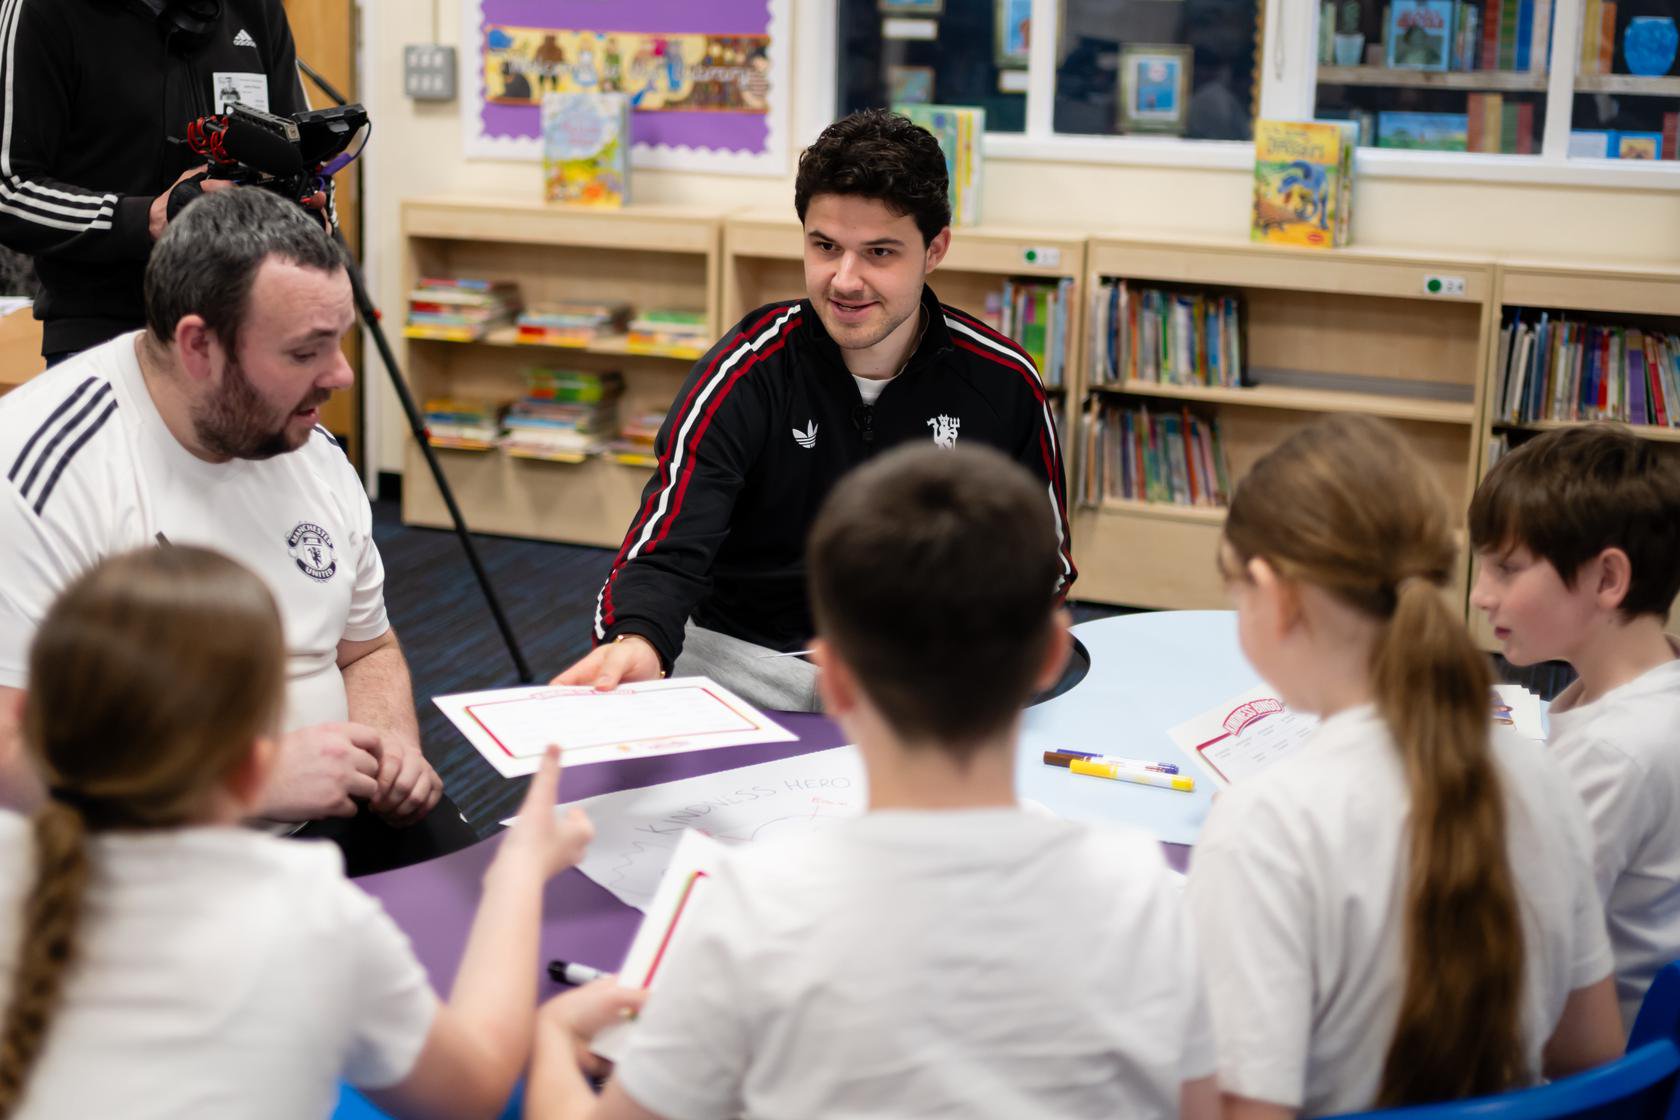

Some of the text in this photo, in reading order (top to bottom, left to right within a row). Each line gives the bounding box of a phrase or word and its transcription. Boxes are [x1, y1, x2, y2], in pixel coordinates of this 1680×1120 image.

[290, 524, 334, 547] MANCHESTER
[304, 566, 335, 578] UNITED
[635, 776, 851, 835] KINDNESS HERO
